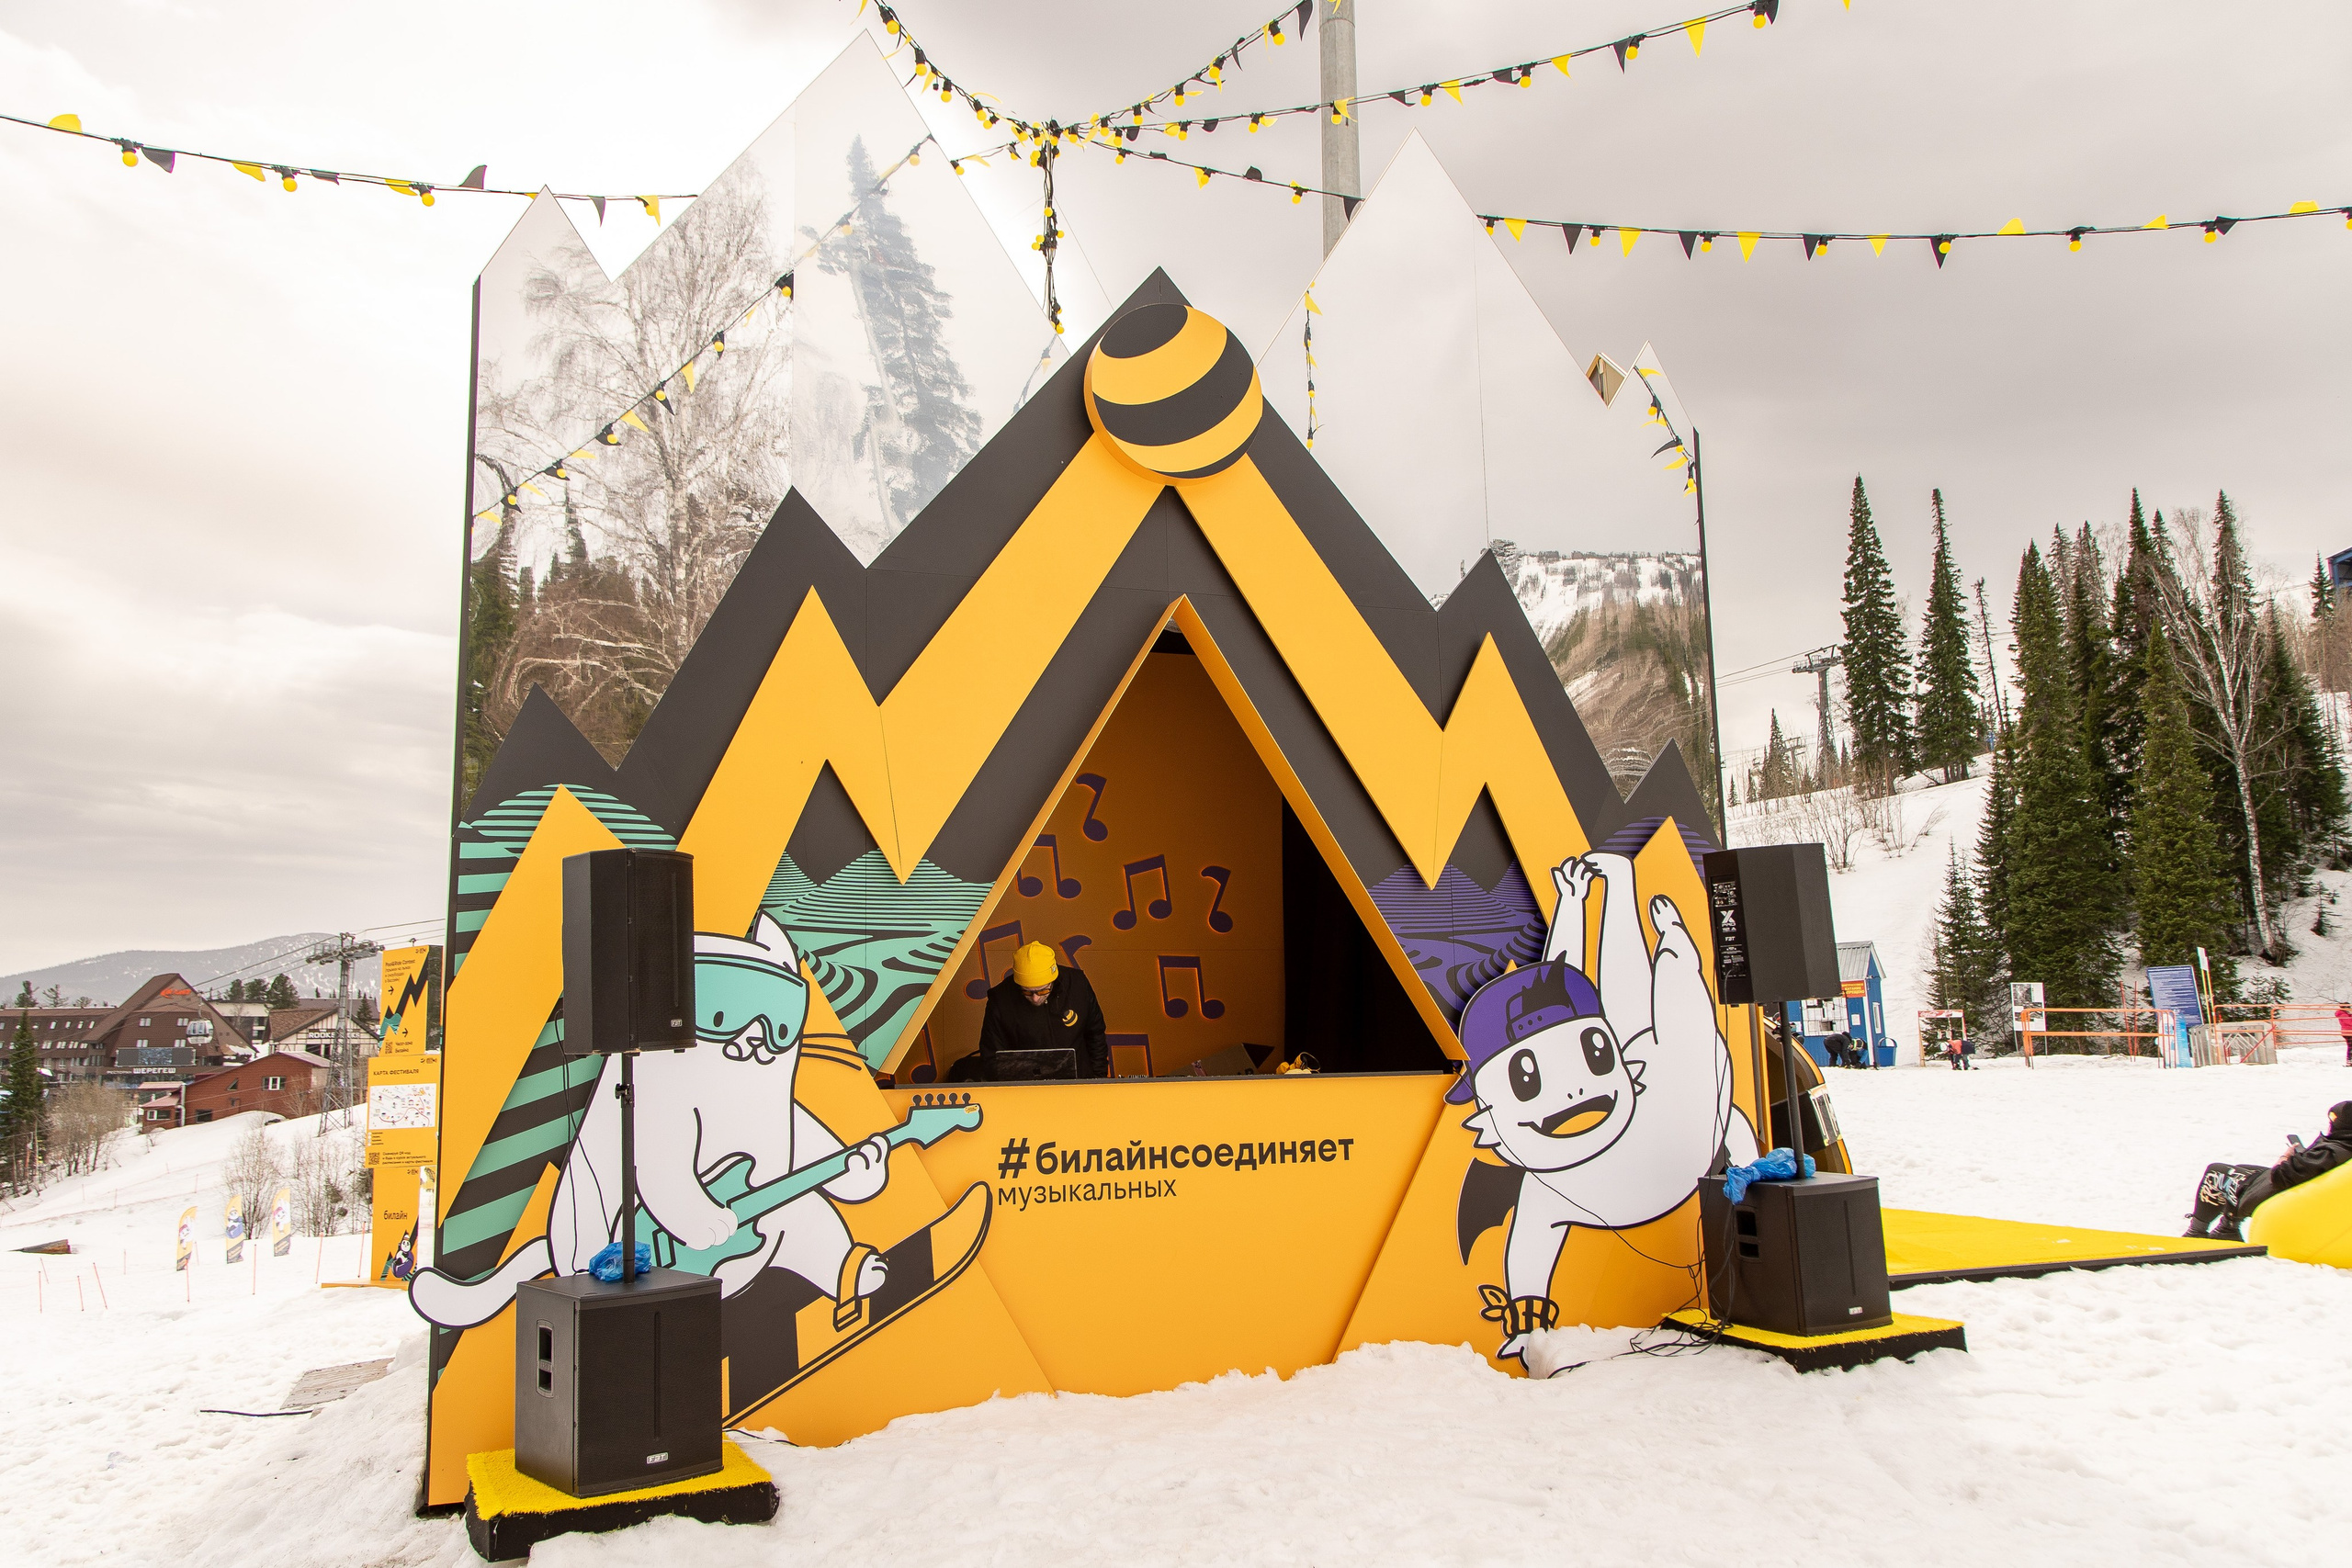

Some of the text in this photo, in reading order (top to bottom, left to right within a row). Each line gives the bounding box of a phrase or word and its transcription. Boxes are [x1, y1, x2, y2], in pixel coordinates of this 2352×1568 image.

[998, 1137, 1354, 1179] #билайнсоединяет
[998, 1179, 1177, 1212] музыкальных
[384, 1210, 408, 1220] билайн
